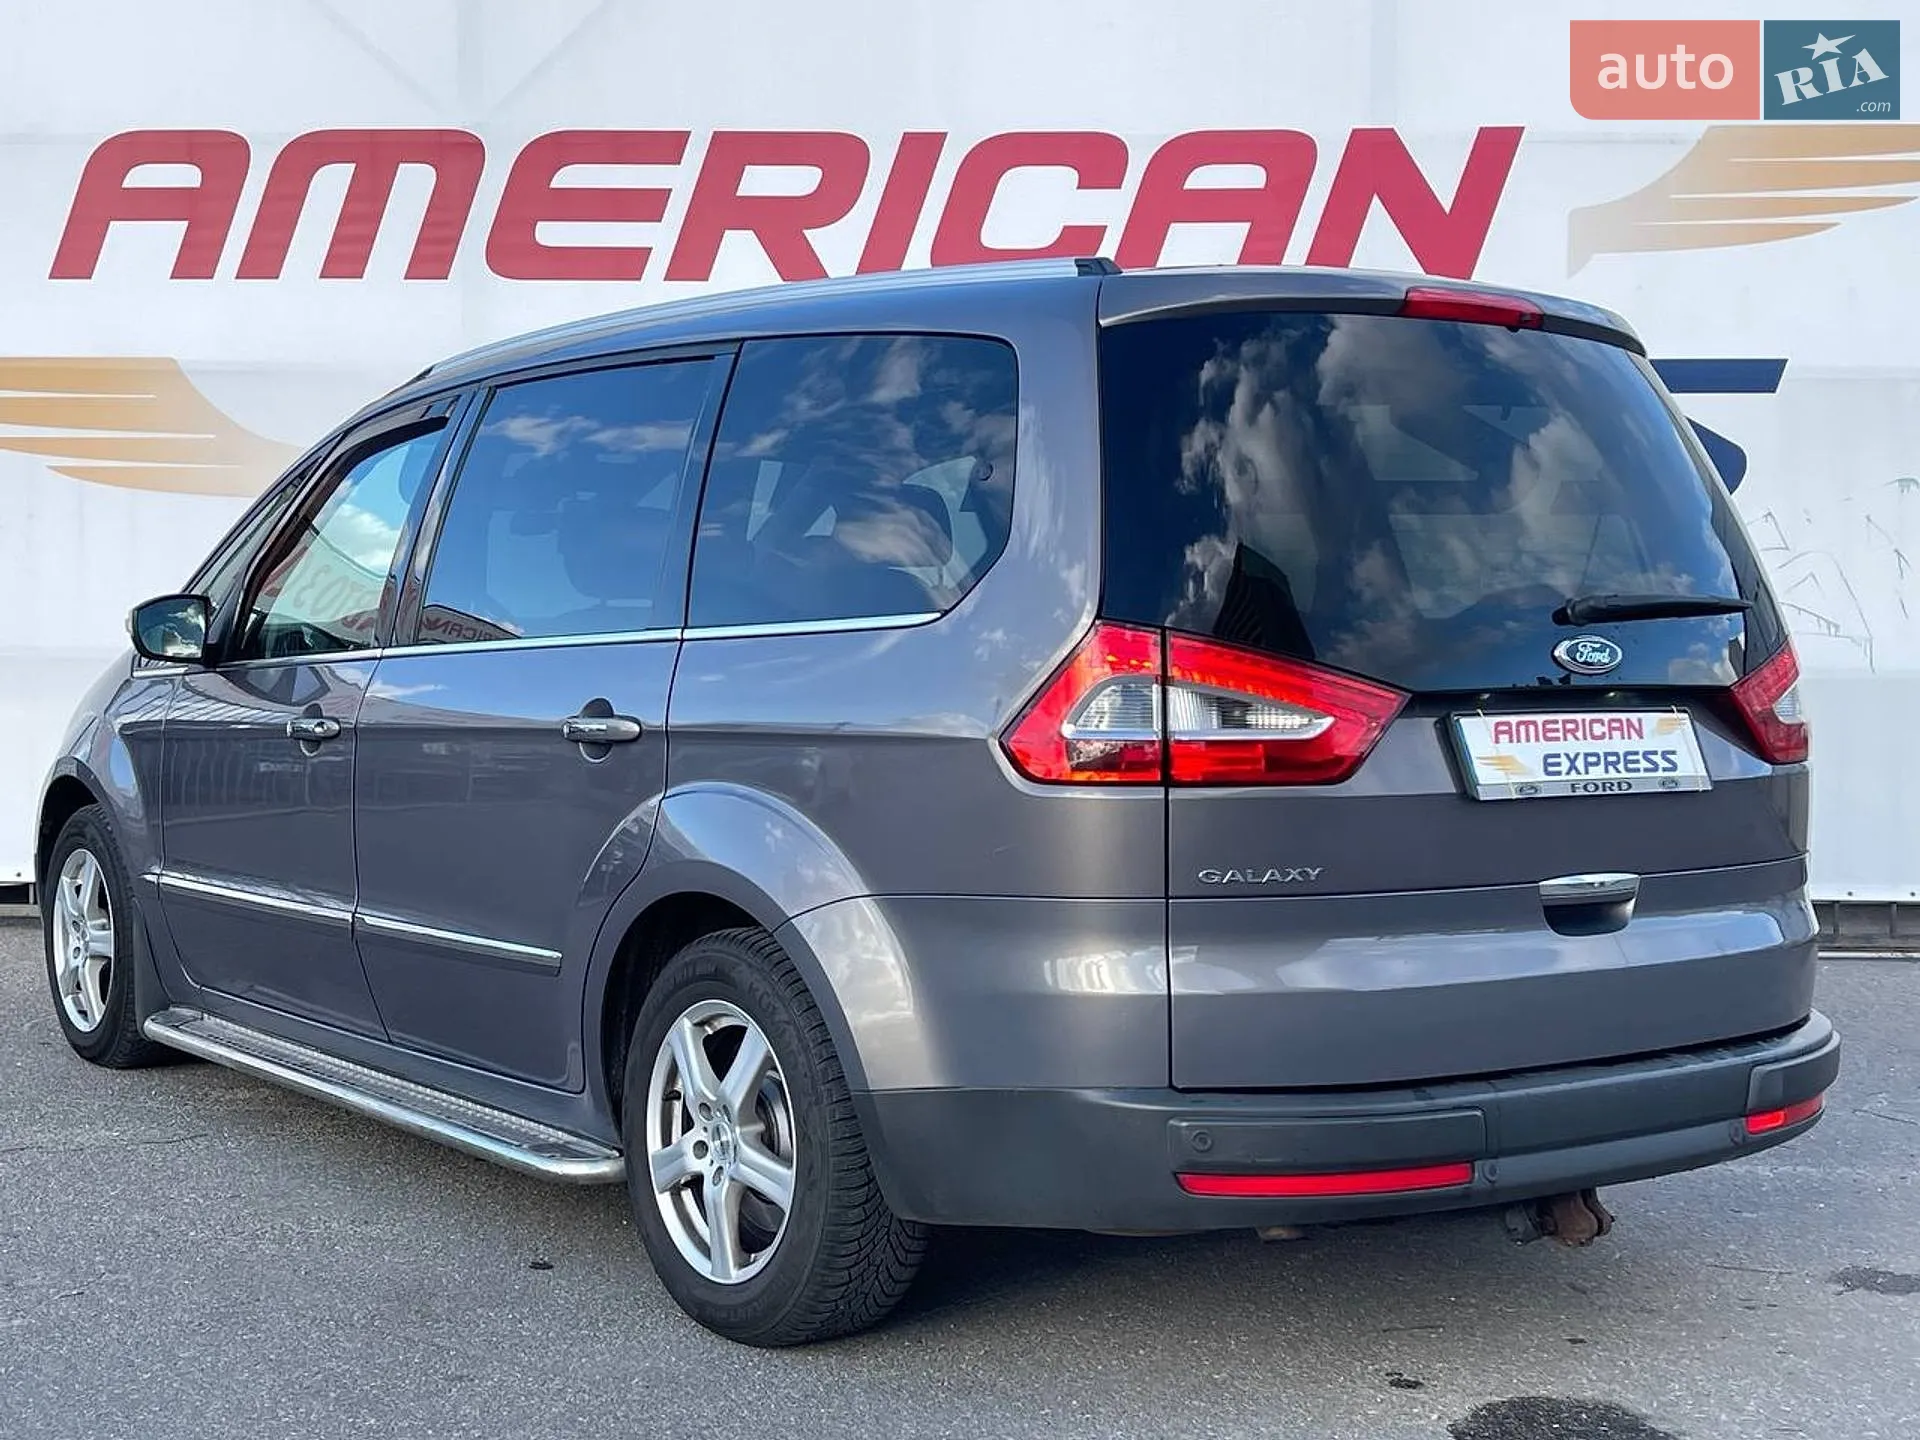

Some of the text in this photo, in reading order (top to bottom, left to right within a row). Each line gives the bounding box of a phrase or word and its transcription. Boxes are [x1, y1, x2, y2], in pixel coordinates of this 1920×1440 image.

[49, 126, 1524, 281] AMERICAN
[1576, 642, 1610, 663] Ford
[1493, 717, 1645, 744] AMERICAN
[1542, 750, 1679, 776] EXPRESS
[1570, 781, 1632, 793] FORD
[1198, 867, 1324, 884] GALAXY
